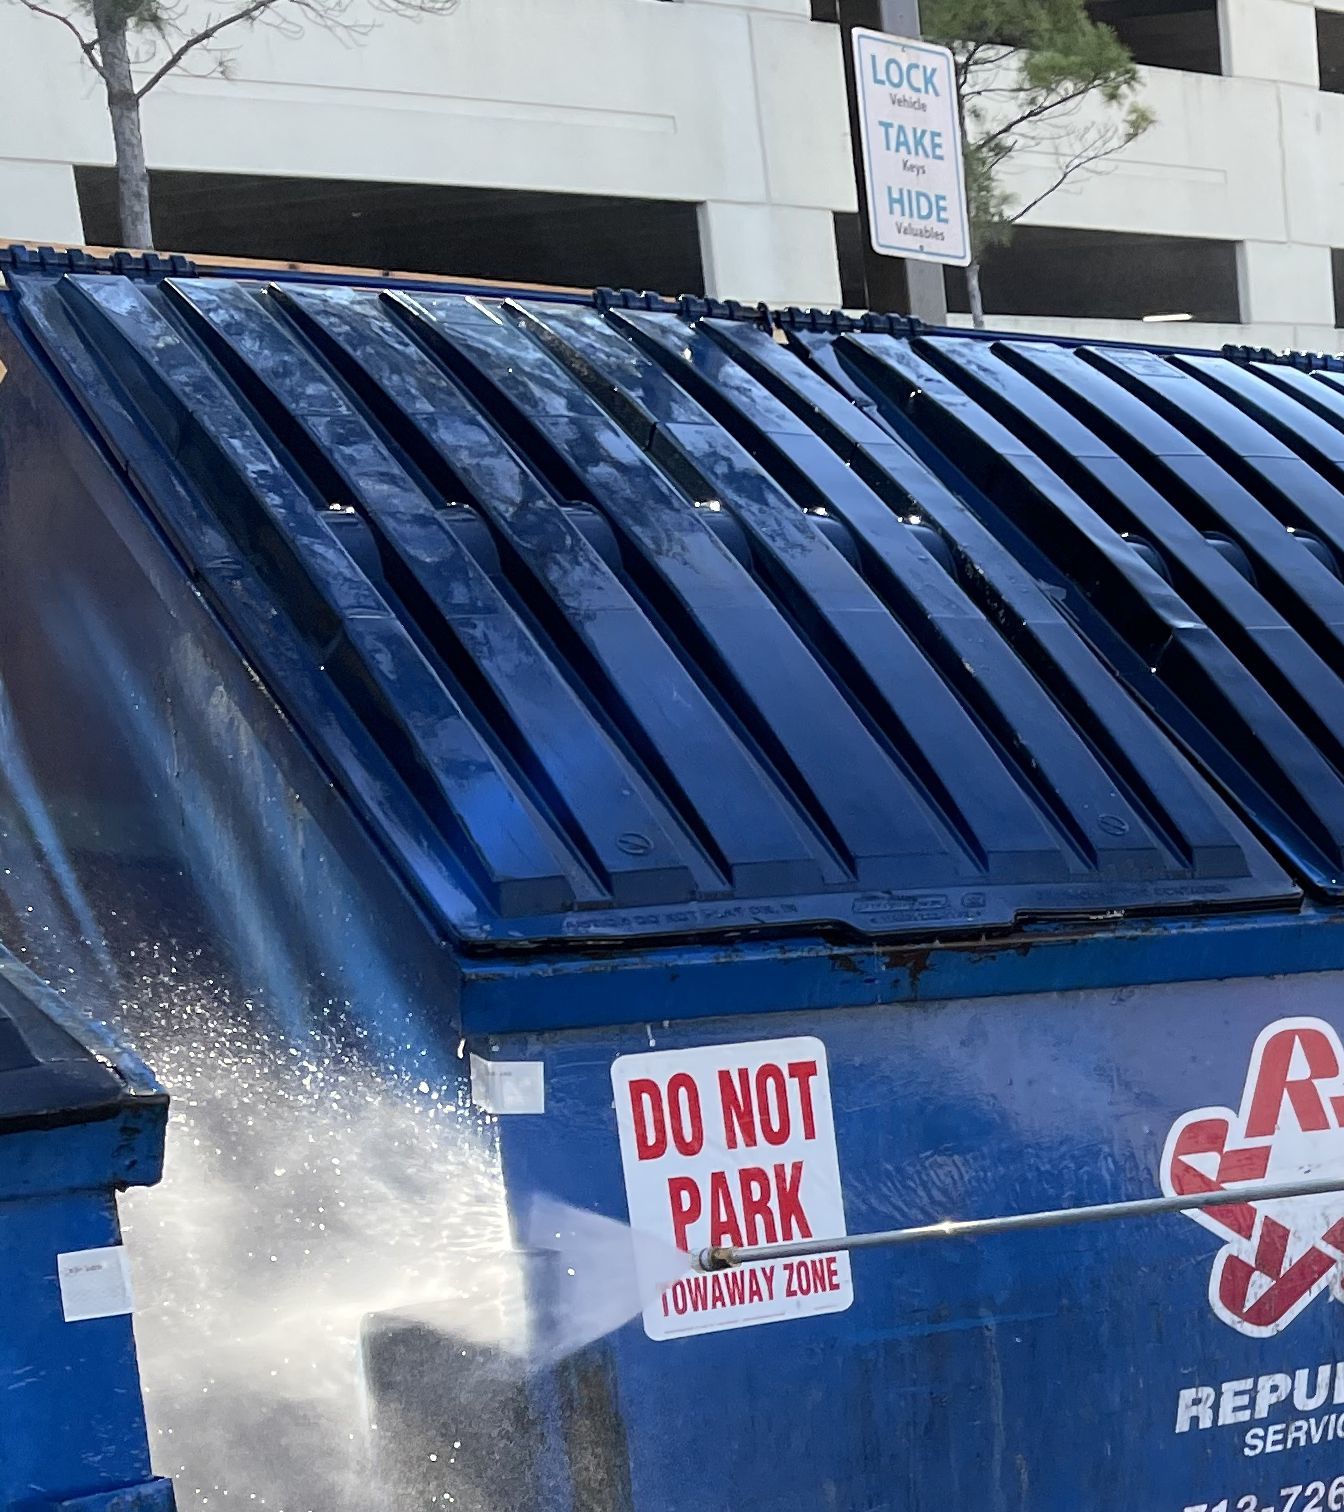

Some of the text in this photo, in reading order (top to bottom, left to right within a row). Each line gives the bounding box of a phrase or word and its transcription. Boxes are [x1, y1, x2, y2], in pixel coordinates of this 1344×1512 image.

[871, 54, 940, 97] LOCK
[890, 92, 928, 113] Vehicle
[878, 120, 945, 161] TAKE
[902, 158, 927, 177] Keys
[887, 185, 949, 225] HIDE
[895, 221, 946, 242] Valuables
[628, 1060, 818, 1162] DO NOT
[667, 1160, 814, 1254] PARK
[783, 1256, 841, 1298] ZONE
